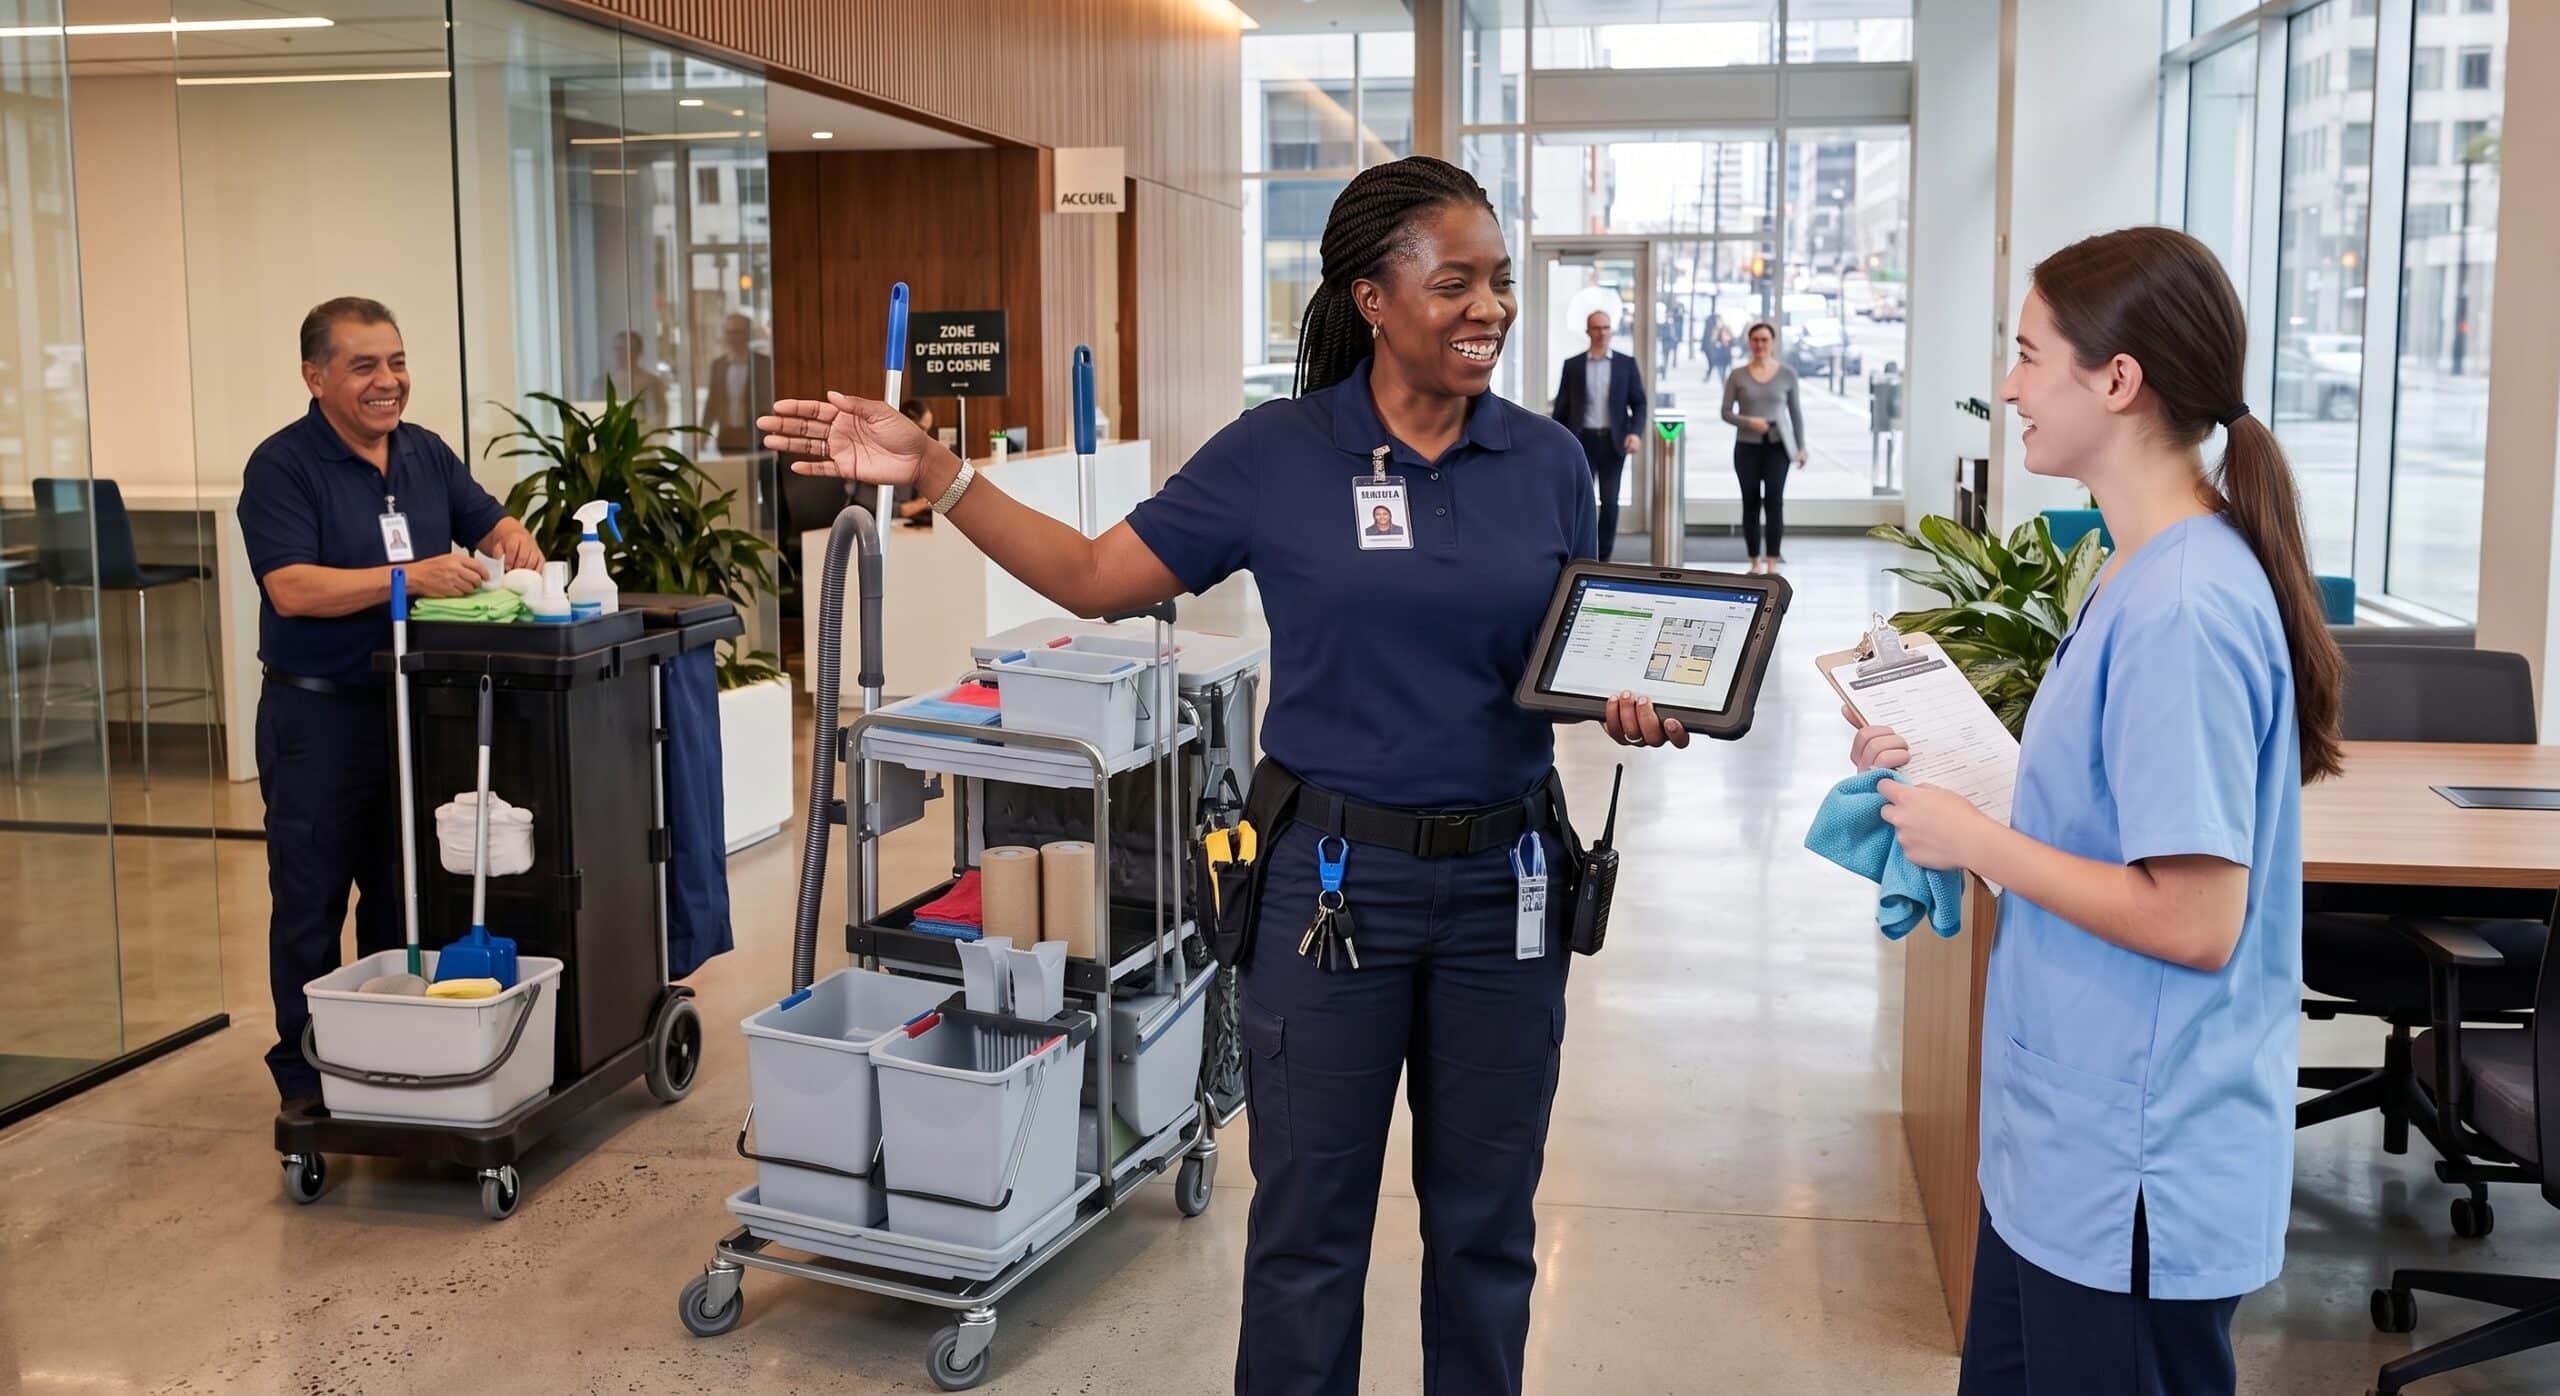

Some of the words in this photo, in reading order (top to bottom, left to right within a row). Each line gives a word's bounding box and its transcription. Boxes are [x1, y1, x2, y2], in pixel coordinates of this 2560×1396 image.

[1061, 192, 1117, 206] ACCUEIL
[939, 325, 976, 338] ZONE
[915, 342, 1000, 356] D'ENTRETIEN
[926, 360, 944, 373] ED
